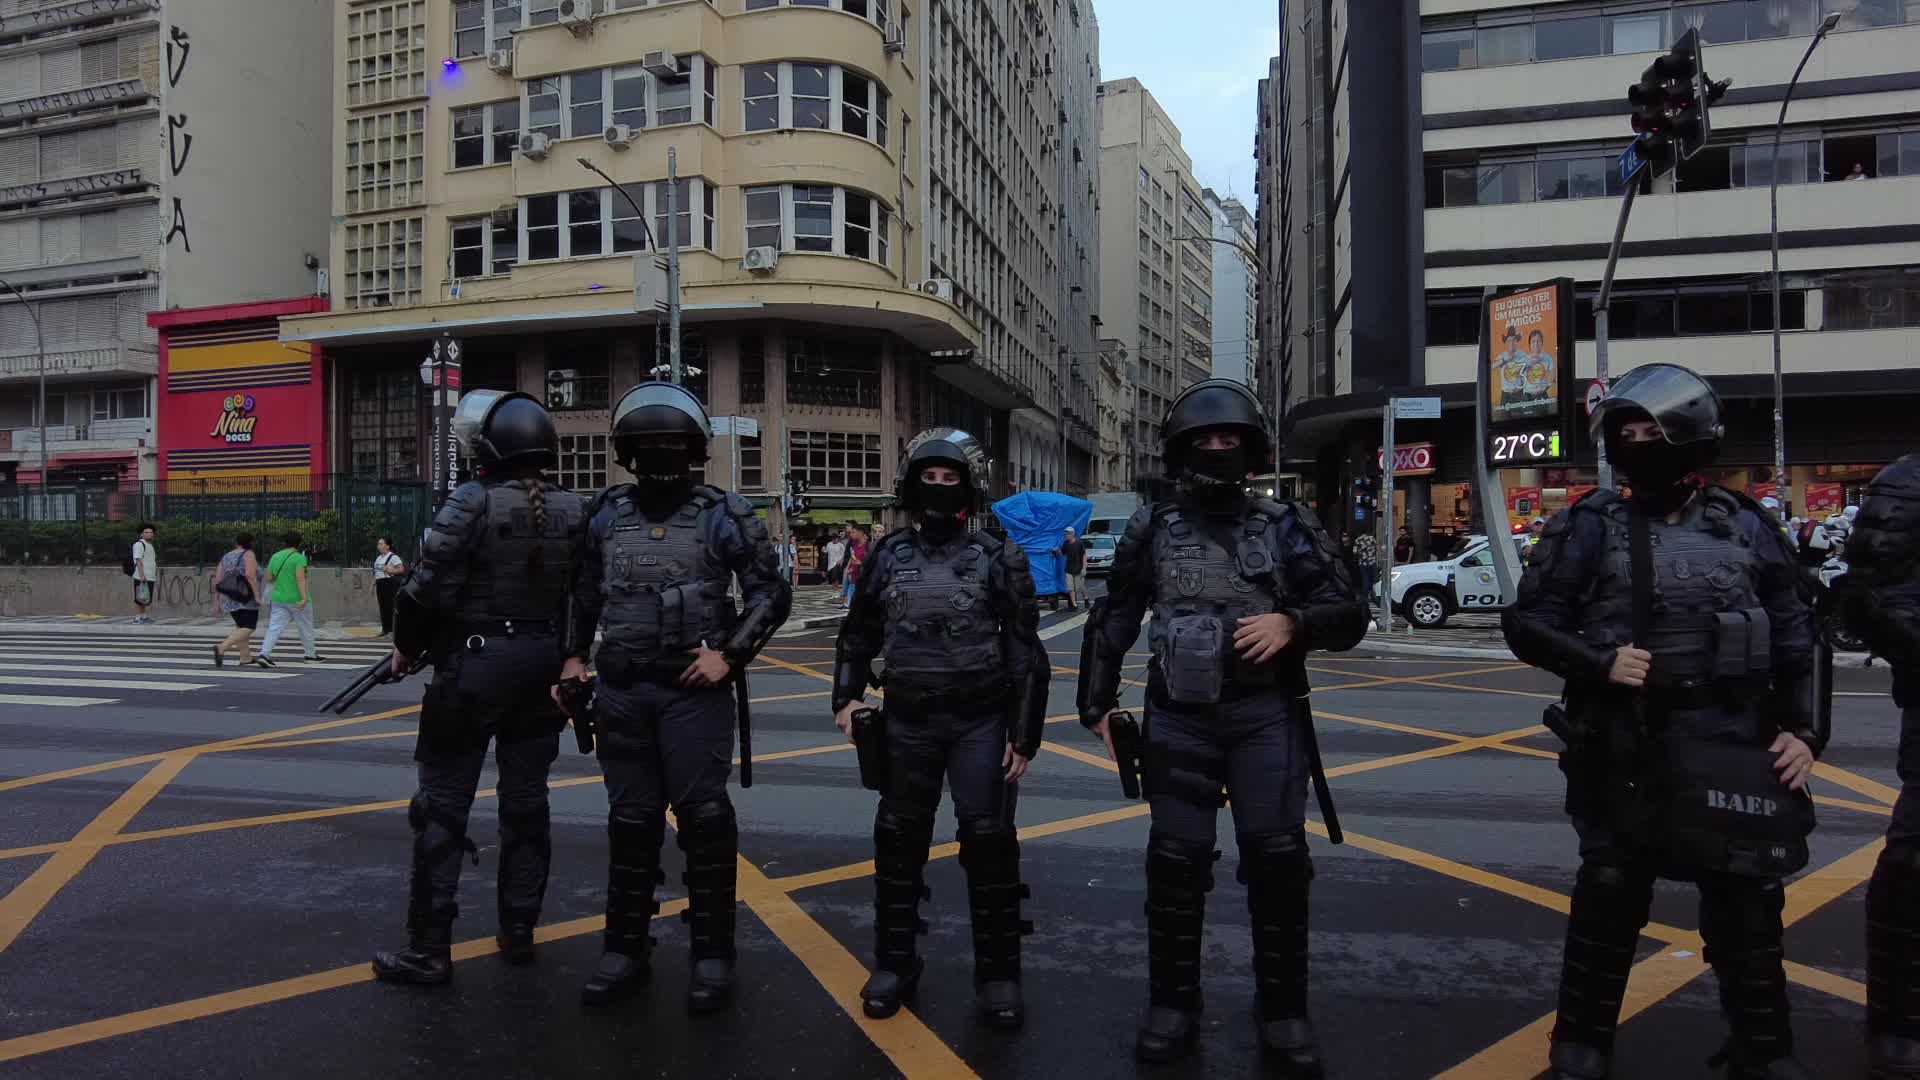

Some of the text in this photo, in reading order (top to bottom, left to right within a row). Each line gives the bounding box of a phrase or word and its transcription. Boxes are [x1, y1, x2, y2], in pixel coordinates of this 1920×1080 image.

[1495, 292, 1550, 311] EU QUERO TER
[1541, 301, 1552, 311] DE
[1505, 313, 1542, 329] AMIGOS
[210, 411, 257, 437] Nina
[225, 433, 252, 442] DOCES
[1494, 432, 1545, 460] 27°C
[1707, 789, 1777, 816] BAEP
